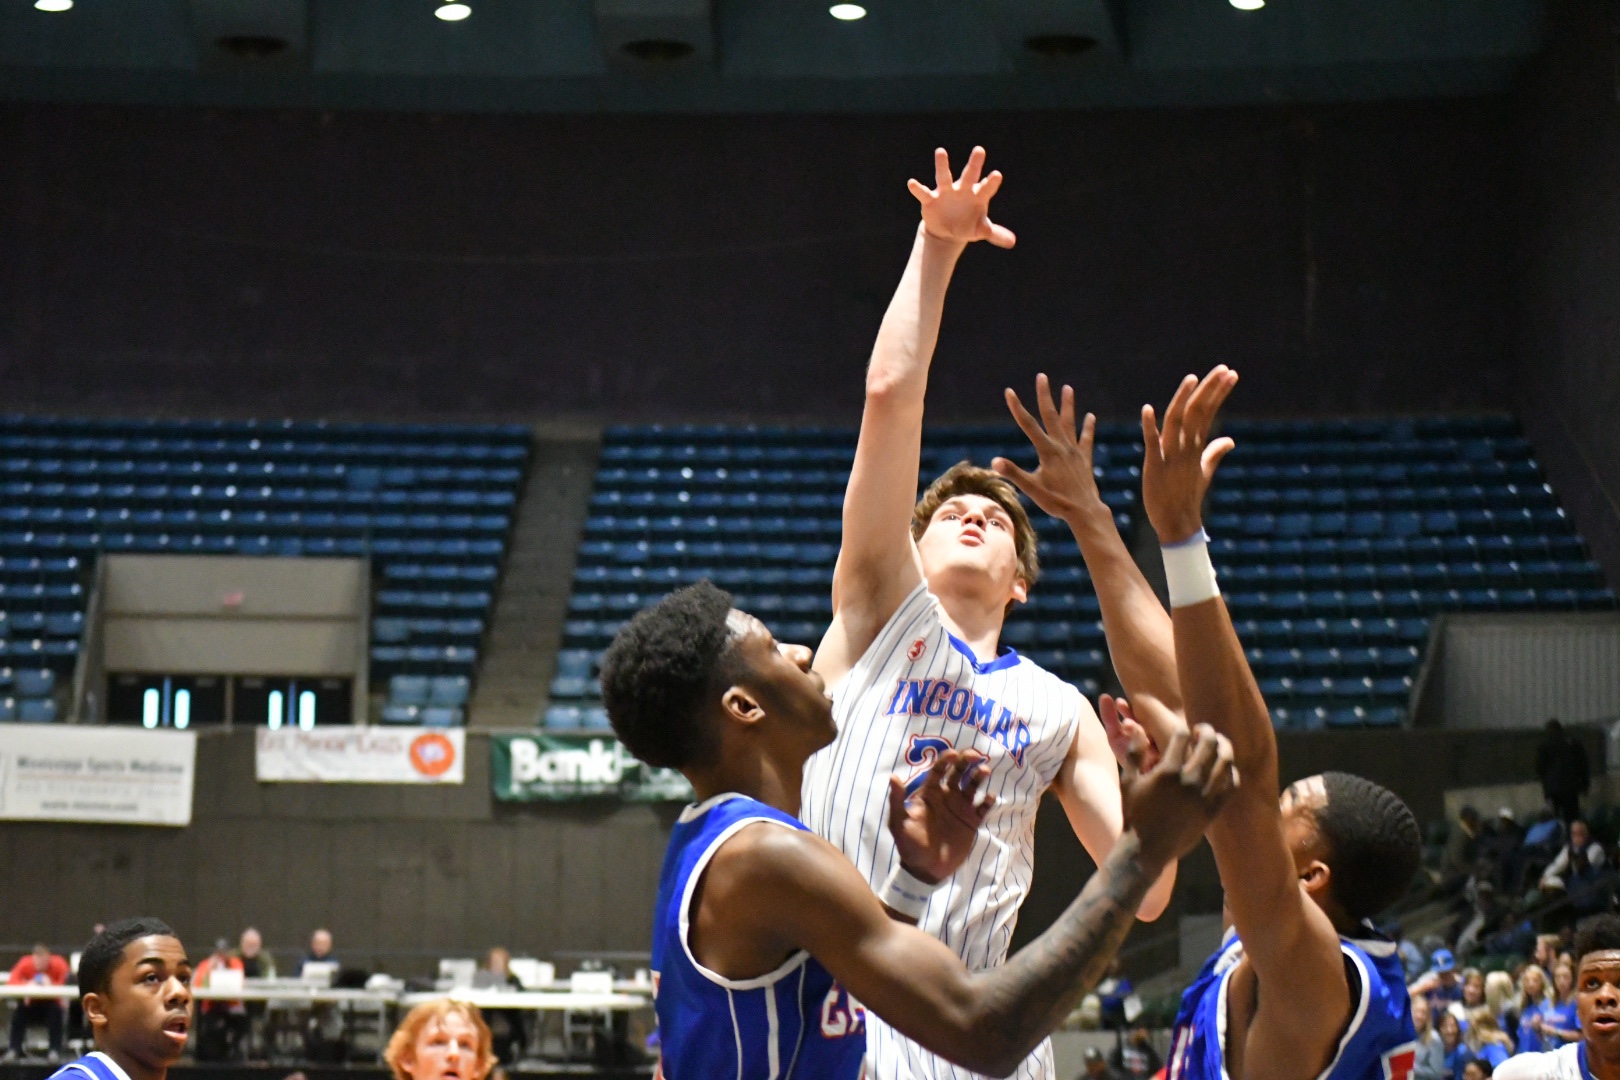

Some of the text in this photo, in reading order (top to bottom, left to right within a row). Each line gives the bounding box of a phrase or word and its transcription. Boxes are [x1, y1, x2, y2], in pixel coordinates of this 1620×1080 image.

[882, 678, 1031, 768] INGOMAR
[88, 757, 125, 773] Sports
[131, 759, 183, 772] Medicine
[510, 738, 640, 783] Bank
